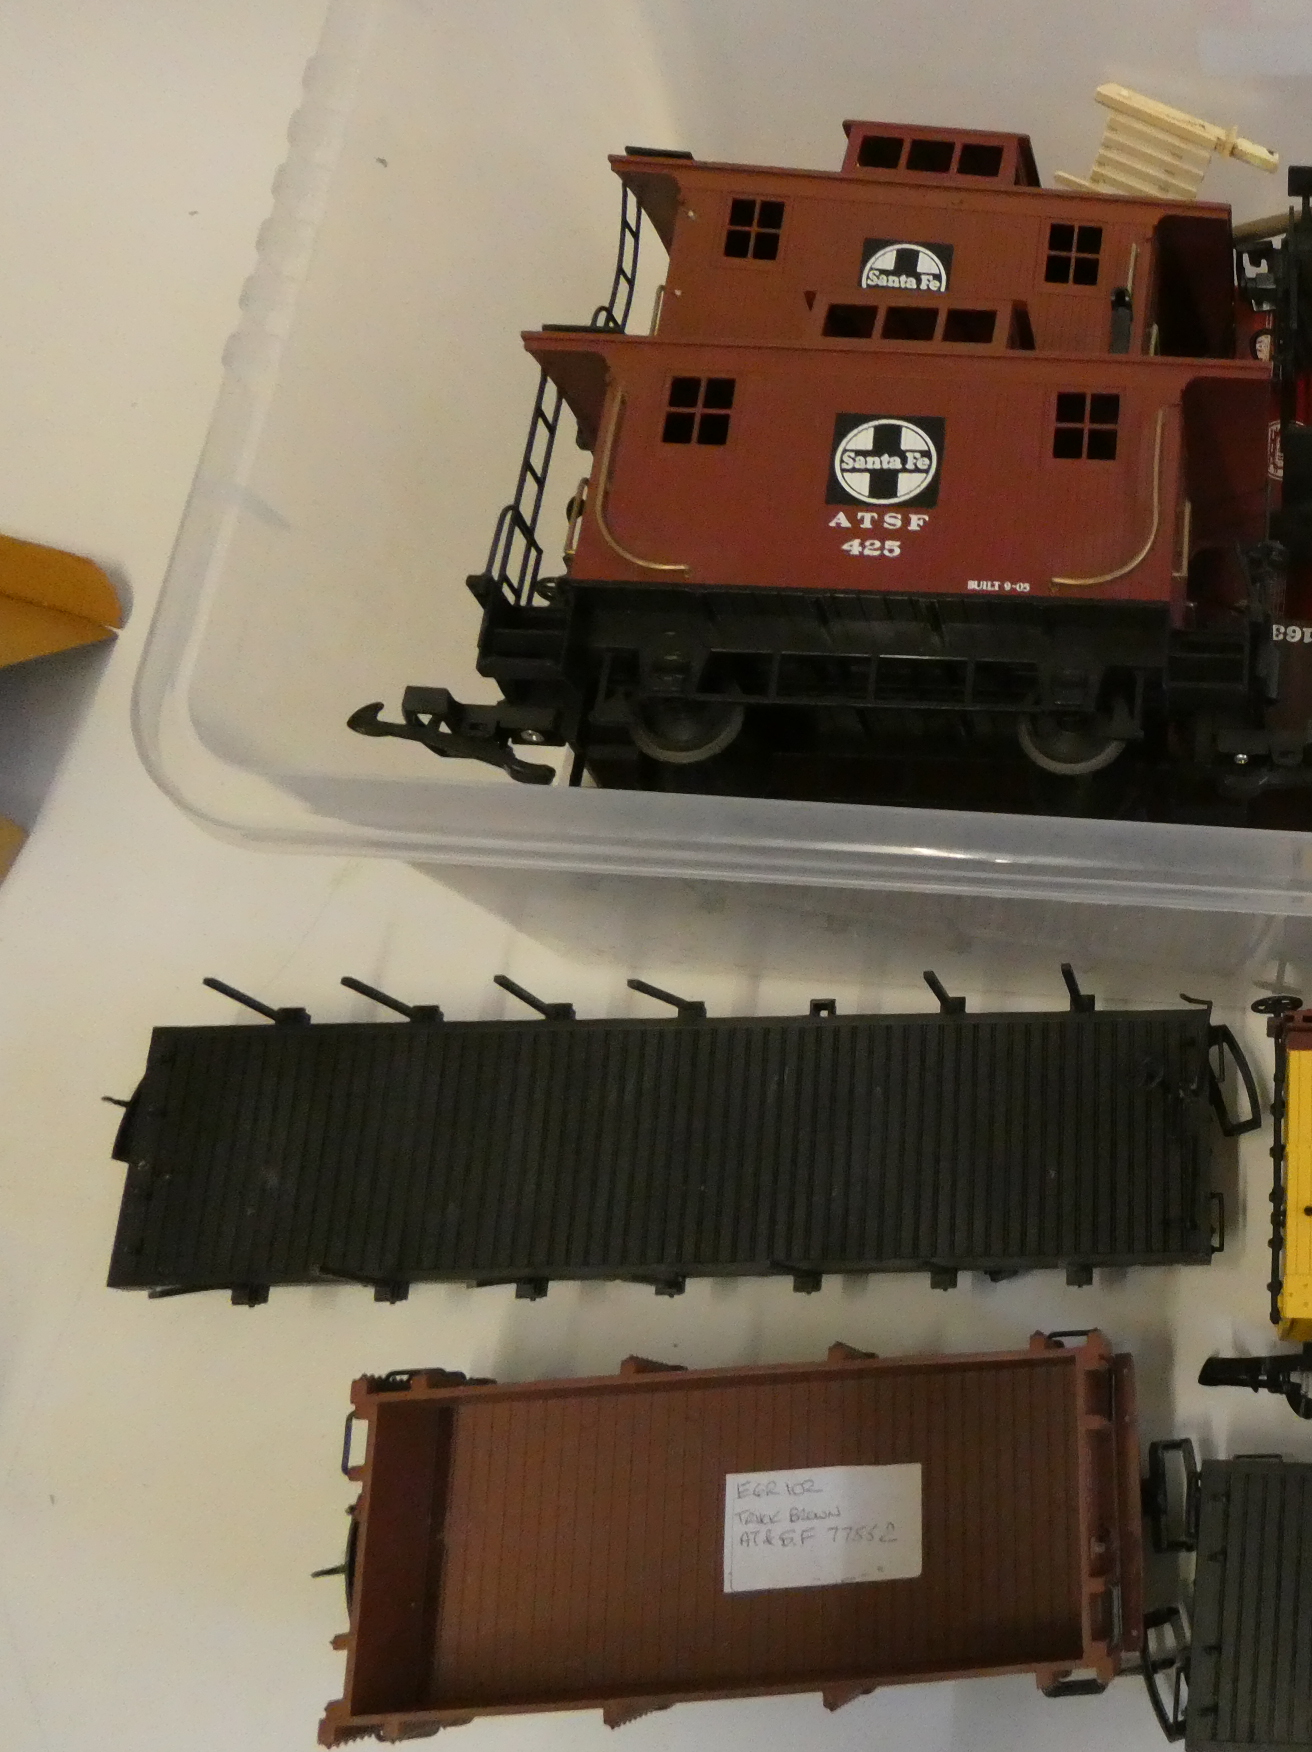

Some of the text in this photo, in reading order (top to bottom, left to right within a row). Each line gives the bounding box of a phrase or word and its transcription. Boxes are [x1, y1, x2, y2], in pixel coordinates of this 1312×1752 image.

[867, 270, 940, 291] Santa Fe
[841, 452, 930, 470] Santa Fe
[841, 539, 901, 558] 425
[967, 580, 1001, 591] BUILT
